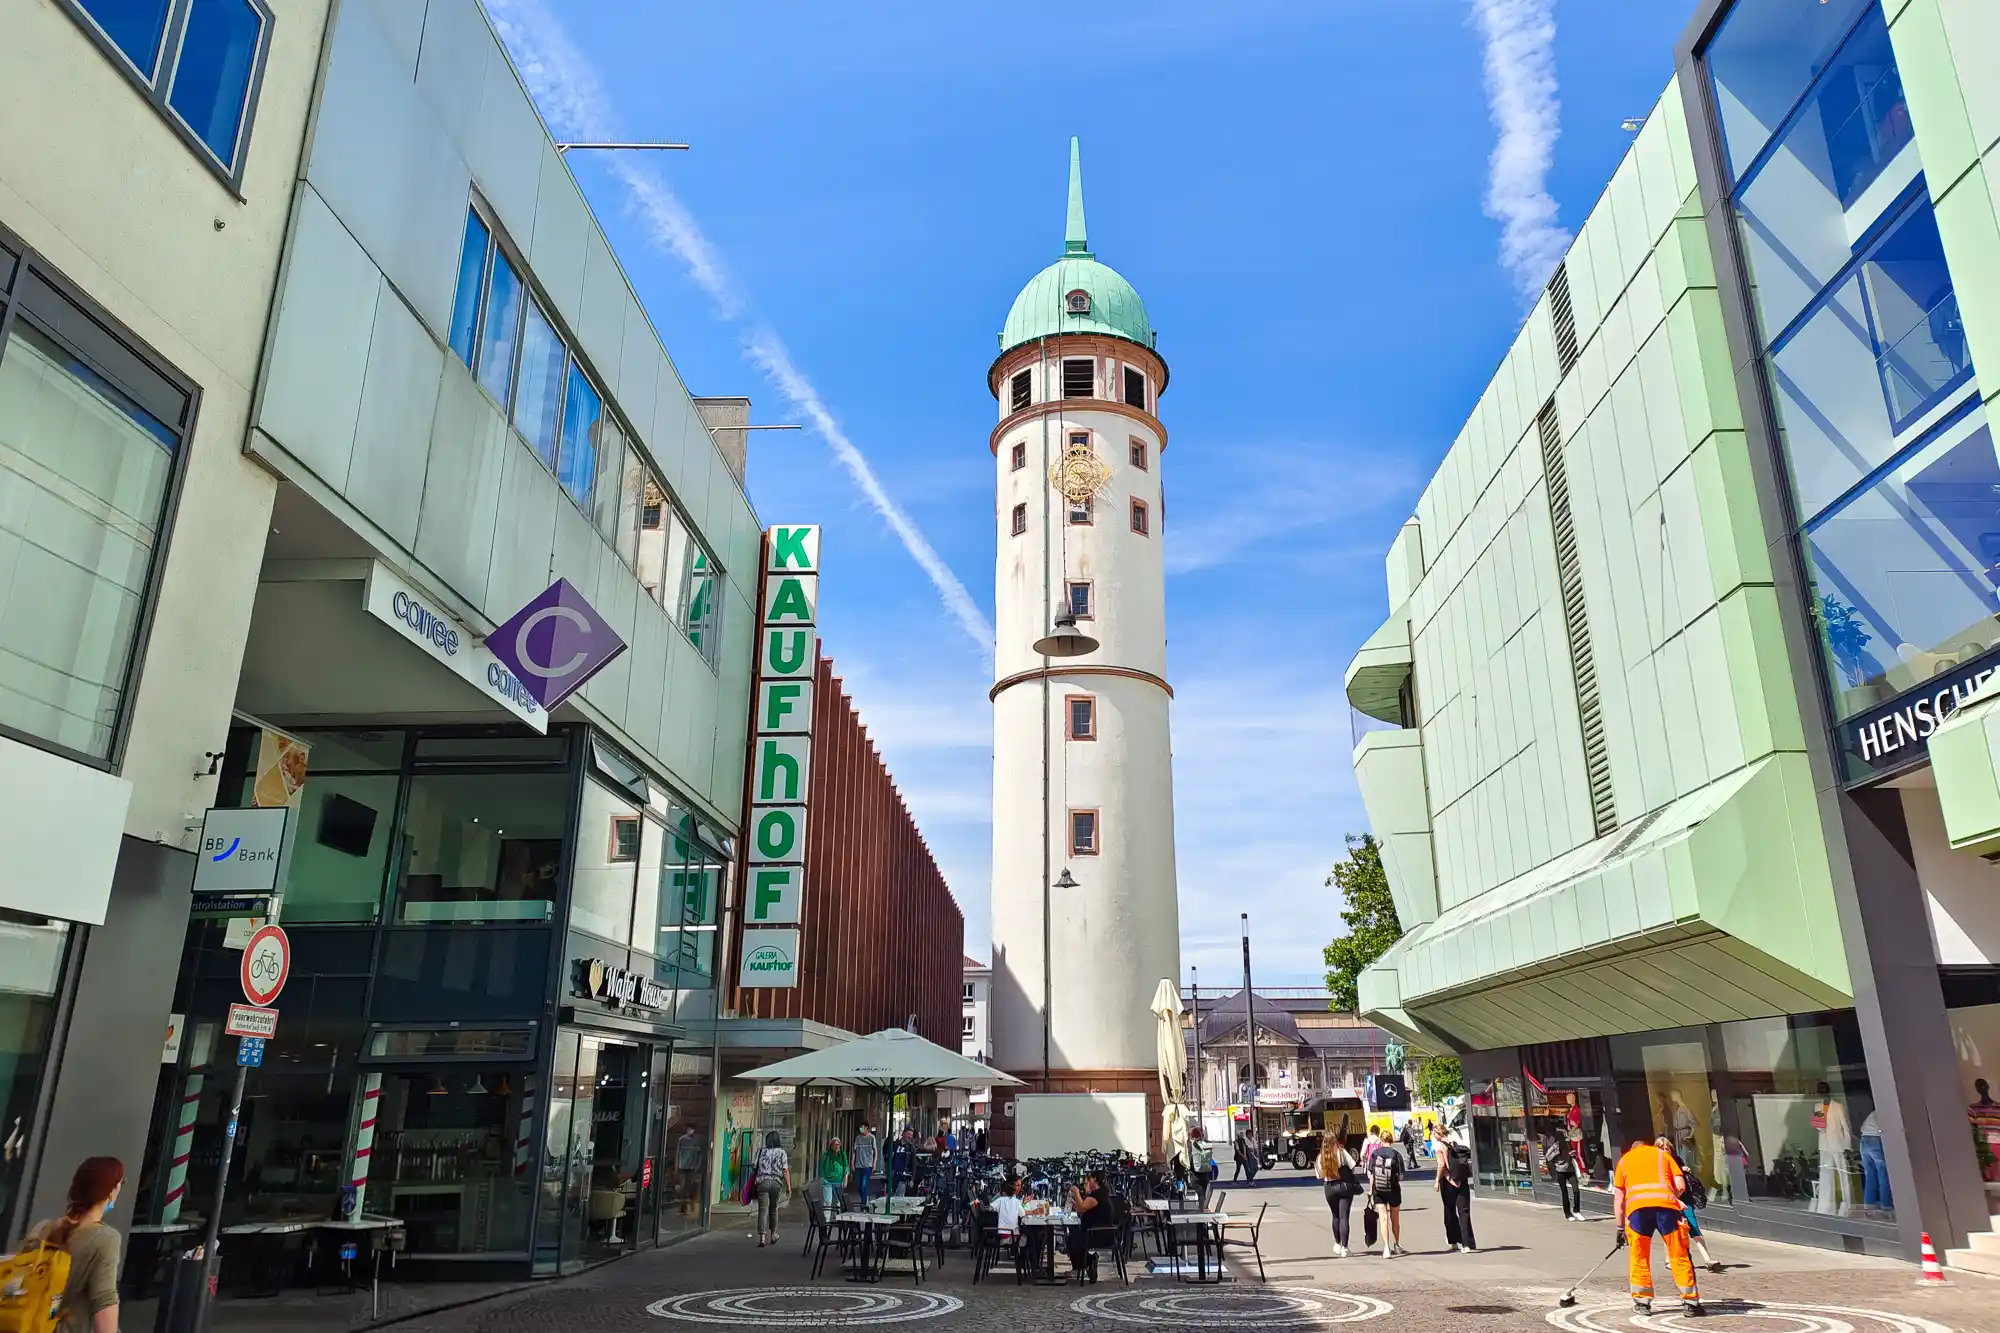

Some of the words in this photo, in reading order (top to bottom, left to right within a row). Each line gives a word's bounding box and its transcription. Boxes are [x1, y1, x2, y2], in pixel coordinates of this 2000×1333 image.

[205, 837, 225, 851] BB
[238, 848, 275, 862] Bank
[192, 900, 245, 910] ntralstation
[755, 951, 778, 960] GALERIA
[605, 965, 638, 1009] Waffel
[639, 975, 664, 1010] House
